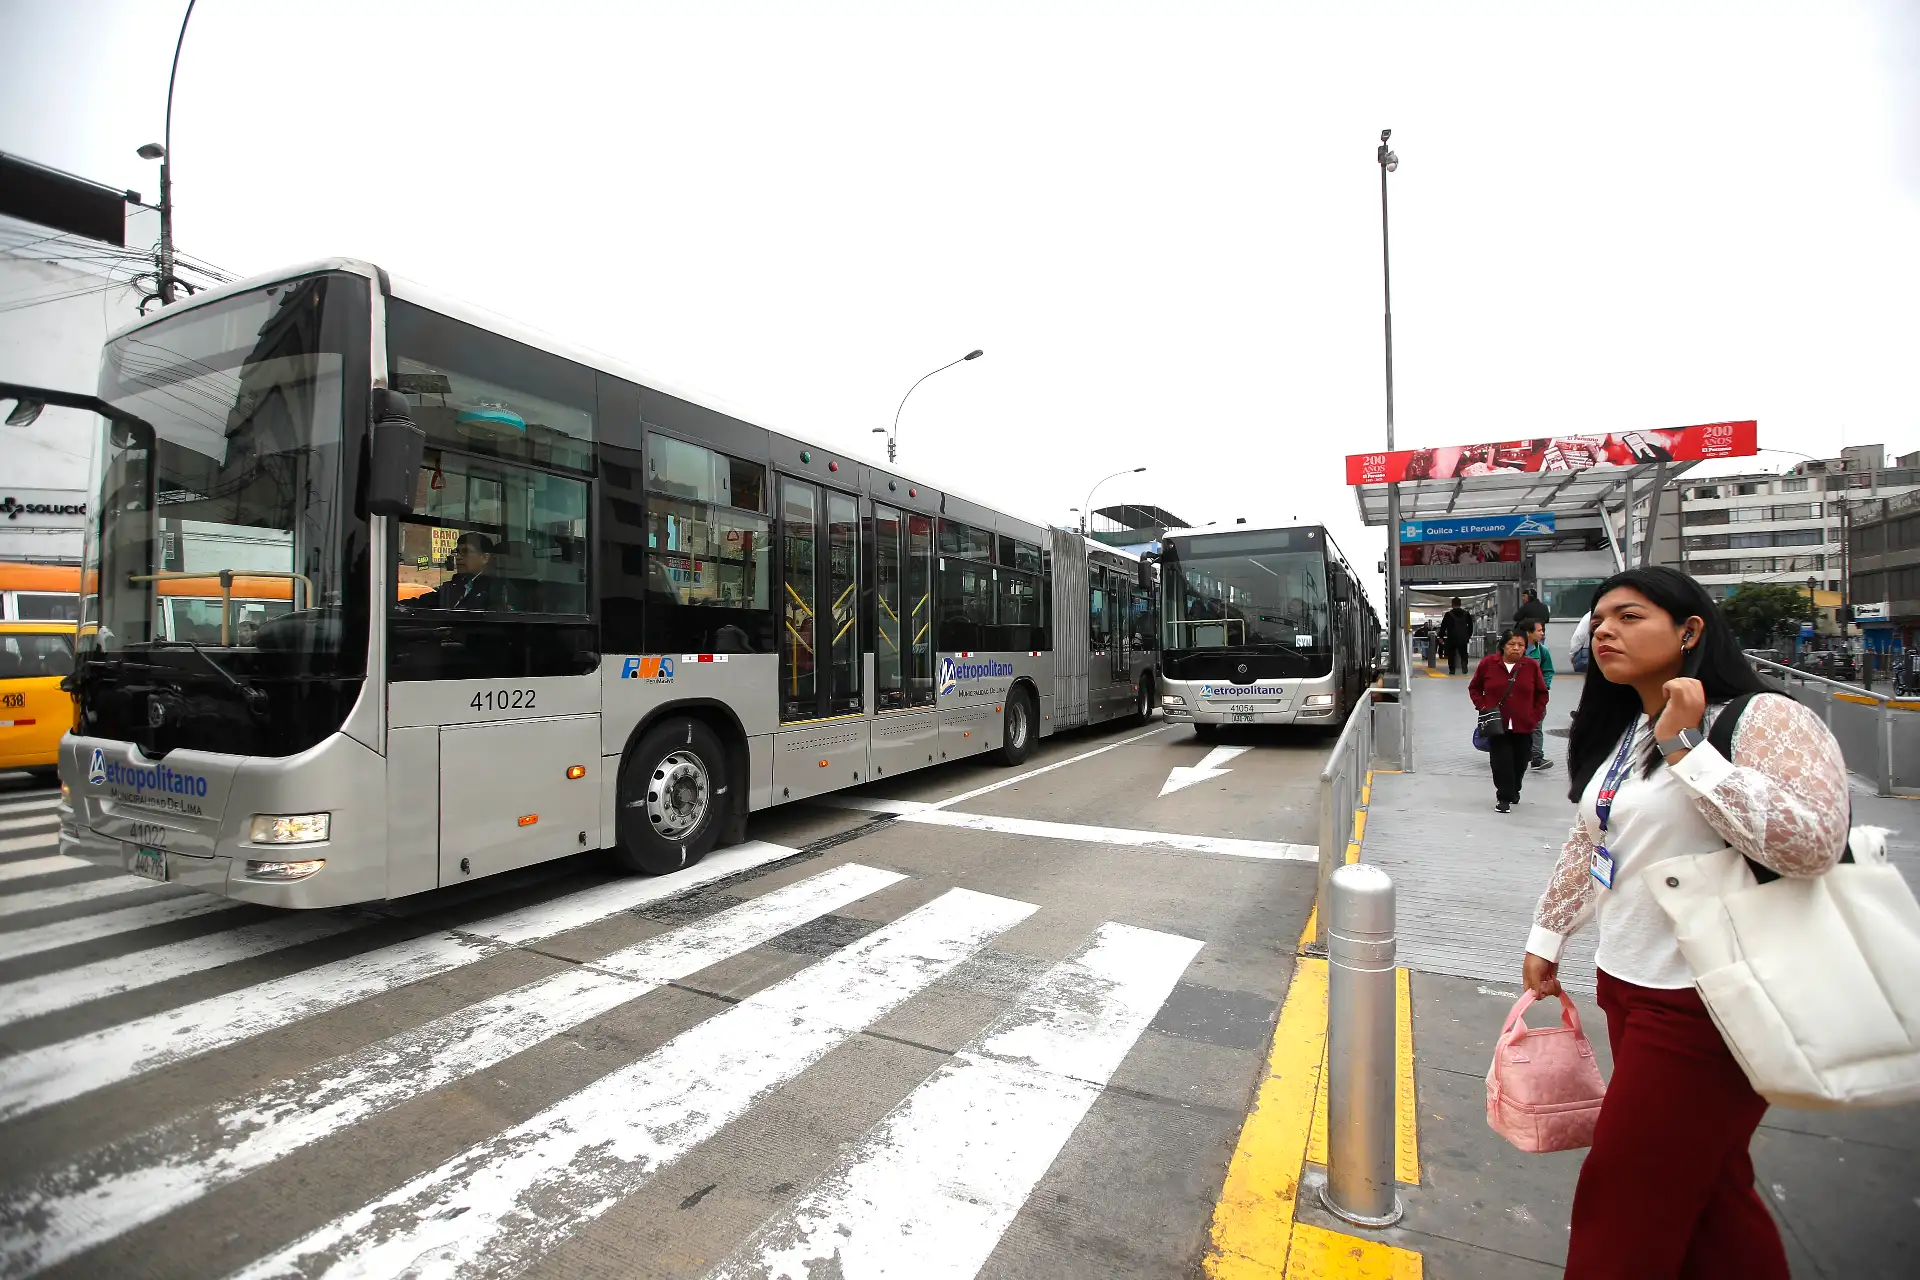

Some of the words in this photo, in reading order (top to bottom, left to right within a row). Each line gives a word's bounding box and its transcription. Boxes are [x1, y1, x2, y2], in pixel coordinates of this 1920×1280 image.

[1702, 425, 1733, 438] 200
[1701, 437, 1732, 446] AÑOS
[1362, 455, 1386, 466] 200
[1406, 525, 1416, 538] B
[1427, 527, 1453, 535] Quilca
[1470, 524, 1506, 533] Peruano
[939, 657, 1013, 697] Metropolitano
[1199, 684, 1284, 698] Metropolitano
[470, 689, 537, 712] 41022
[1230, 704, 1255, 713] 41054
[89, 748, 208, 797] Metropolitano
[129, 822, 167, 848] 41022
